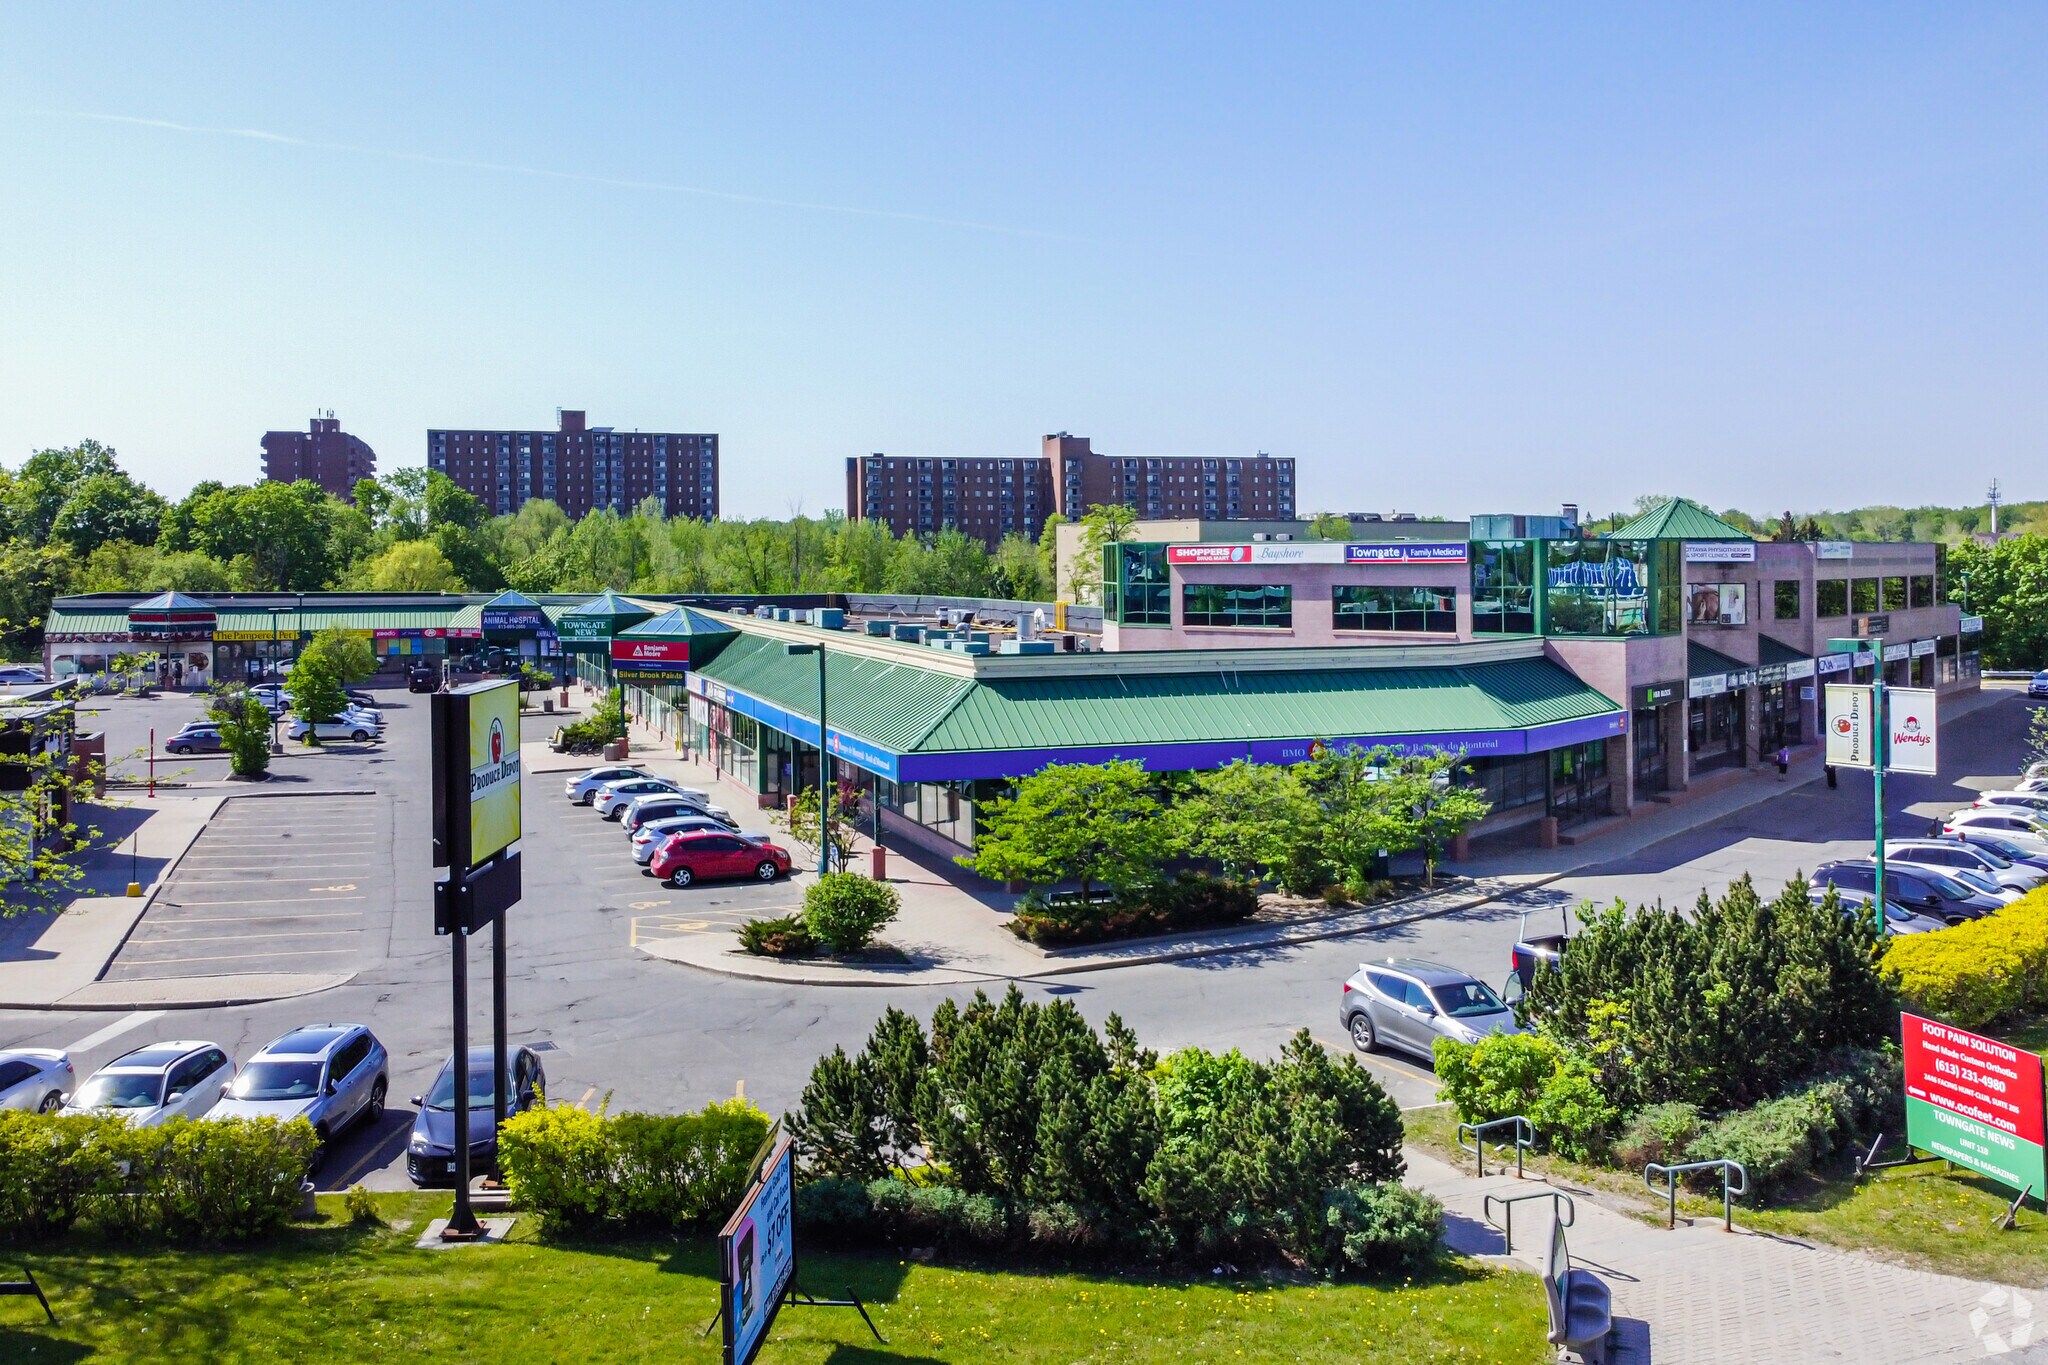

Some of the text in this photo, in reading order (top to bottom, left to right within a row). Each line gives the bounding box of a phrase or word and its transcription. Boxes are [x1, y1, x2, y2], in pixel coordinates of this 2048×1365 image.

[1176, 548, 1230, 556] SHOPPERS
[1258, 547, 1304, 561] Bayshore
[1351, 547, 1463, 560] Towngate Family Medicine
[483, 616, 540, 624] ANIMAL HOSPITAL
[563, 621, 606, 629] TOWNGATE
[216, 631, 232, 640] The
[279, 631, 292, 640] Pet
[575, 628, 597, 636] NEWS
[644, 644, 668, 653] Benjamin
[1850, 691, 1859, 762] PRODUCE DEPOT
[1460, 739, 1498, 750] Montréal
[1893, 731, 1931, 746] Wendy's
[1282, 749, 1306, 758] BMO
[470, 759, 519, 792] PRODUCE DEPOT
[1922, 1022, 2017, 1063] FOOT PAIN SOLUTION
[1922, 1040, 2018, 1079] Hand Made Custom Orthotics
[1935, 1058, 2006, 1093] (613) 231-4980
[1937, 1077, 1958, 1091] FACING
[1992, 1097, 2008, 1110] SUITE
[1929, 1092, 2017, 1133] www.ocofeet.com
[1933, 1109, 2015, 1150] TOWNGATE NEWS
[1959, 1137, 1989, 1156] UNIT 118
[1931, 1141, 2020, 1184] NEWSPAPERS & MAGAZINES
[767, 1220, 776, 1255] $7
[776, 1200, 789, 1238] OFF
